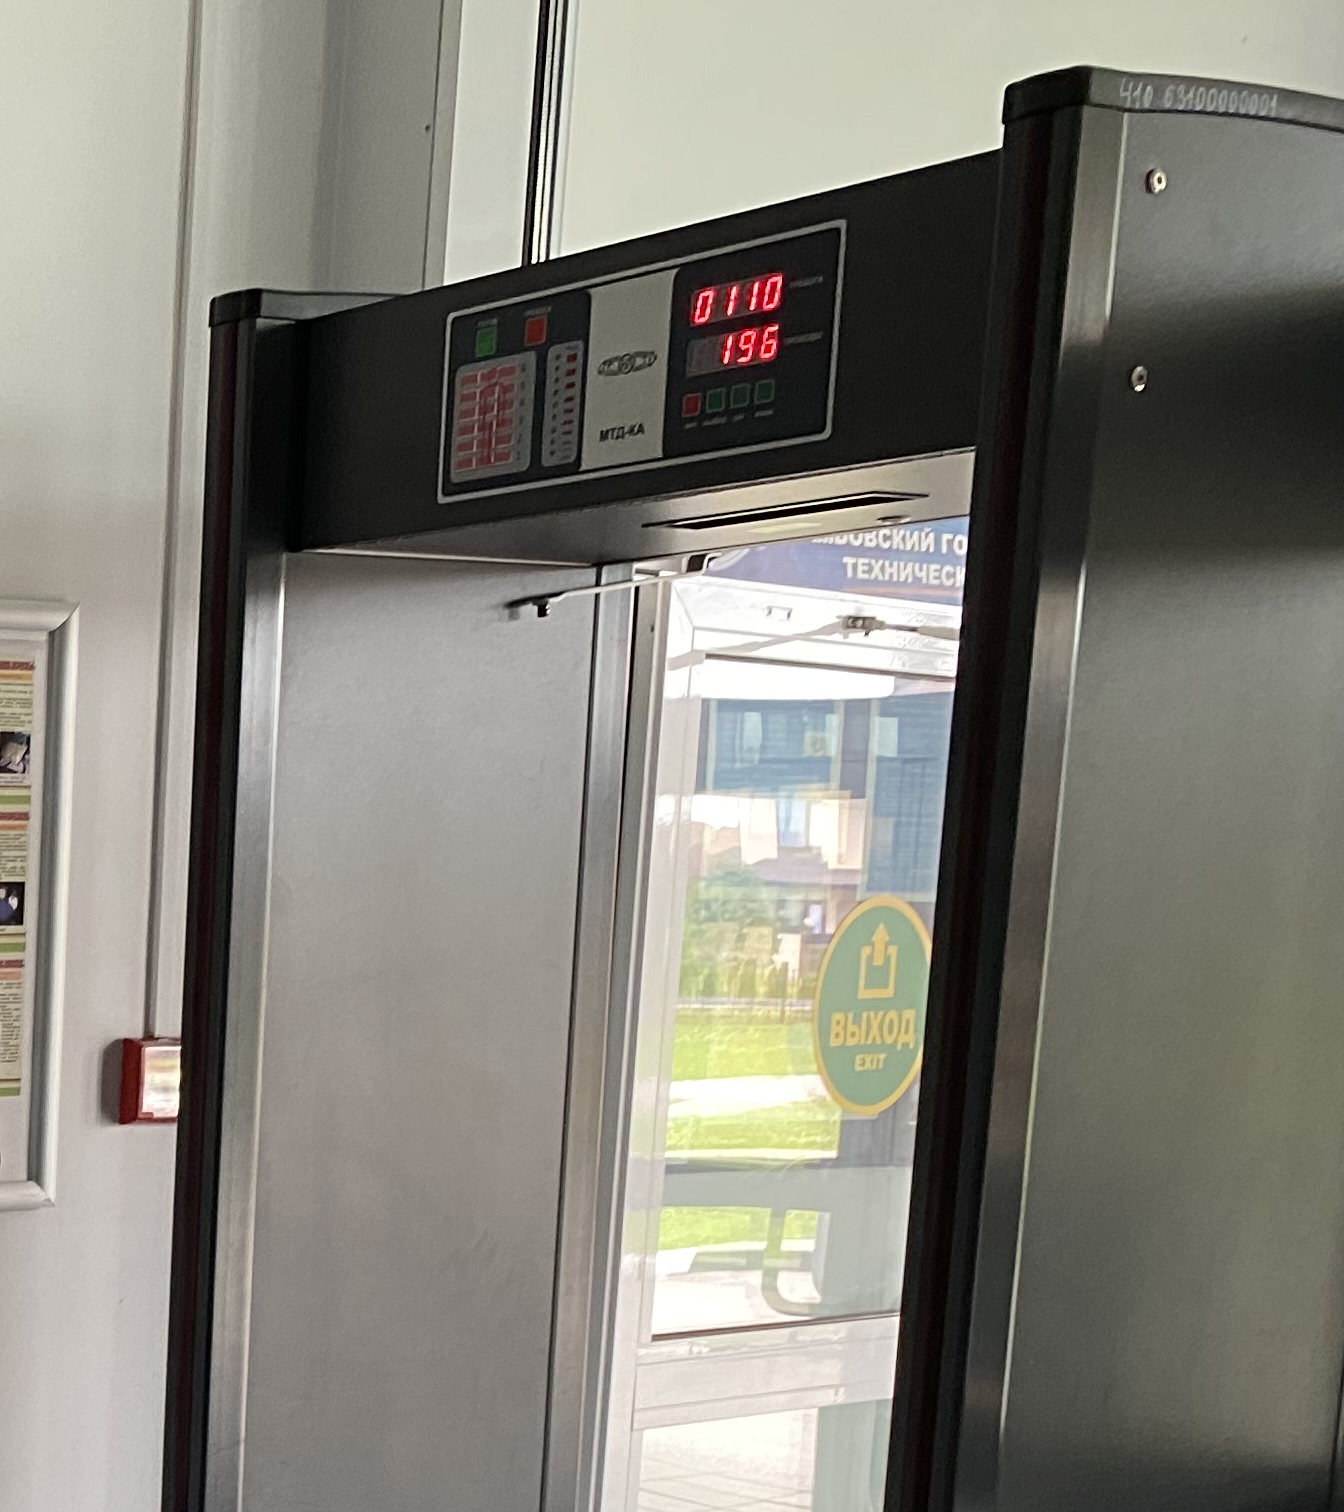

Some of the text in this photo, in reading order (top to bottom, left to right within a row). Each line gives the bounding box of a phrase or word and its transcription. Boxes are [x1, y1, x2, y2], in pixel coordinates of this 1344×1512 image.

[693, 274, 783, 324] 0110
[722, 323, 780, 365] 196
[812, 527, 934, 553] ОВСКИЙ
[830, 1008, 915, 1050] ВЫХОД
[854, 1053, 887, 1071] EXIT
